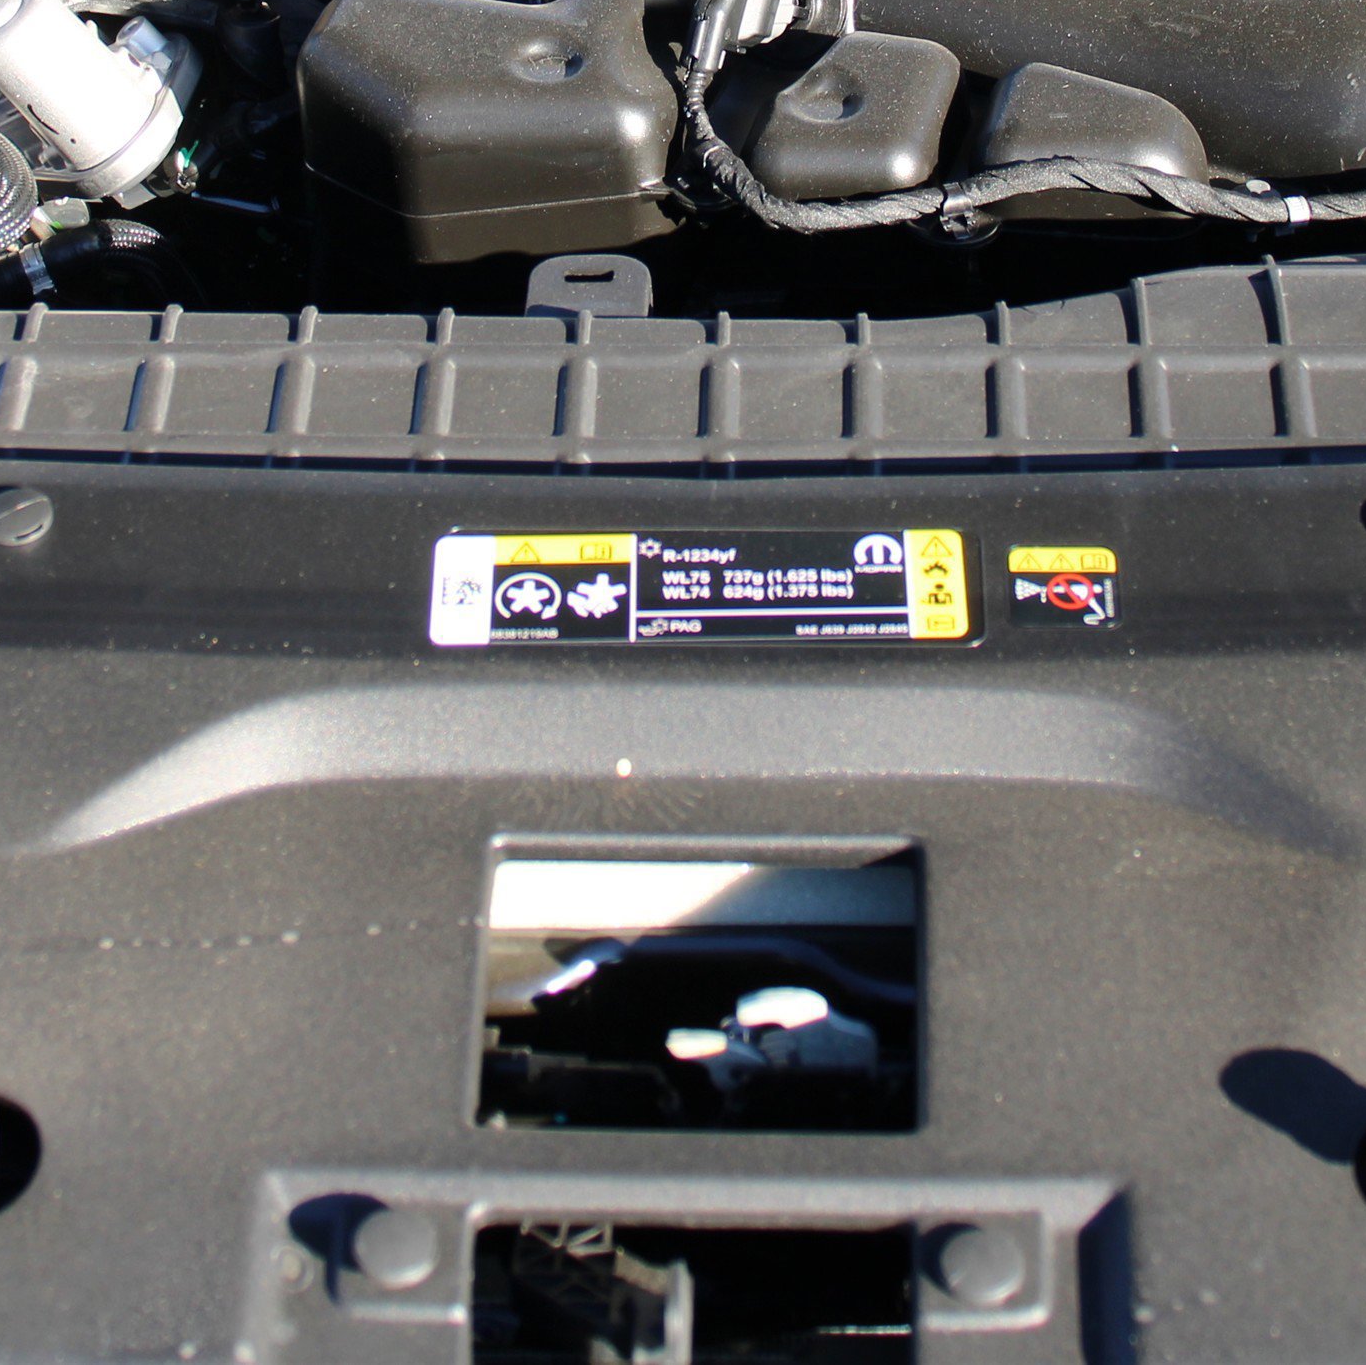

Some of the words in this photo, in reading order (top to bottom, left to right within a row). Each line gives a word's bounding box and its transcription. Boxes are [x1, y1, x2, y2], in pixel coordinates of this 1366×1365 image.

[662, 547, 737, 565] R-1234yf
[662, 570, 712, 585] WL75
[722, 569, 765, 586] 737g
[767, 568, 819, 586] (1.625
[820, 567, 854, 585] lbs)
[662, 585, 712, 600] WL74
[722, 584, 765, 601] 624g
[767, 583, 819, 601] (1.375
[820, 583, 855, 600] lbs)
[669, 619, 702, 633] PAG
